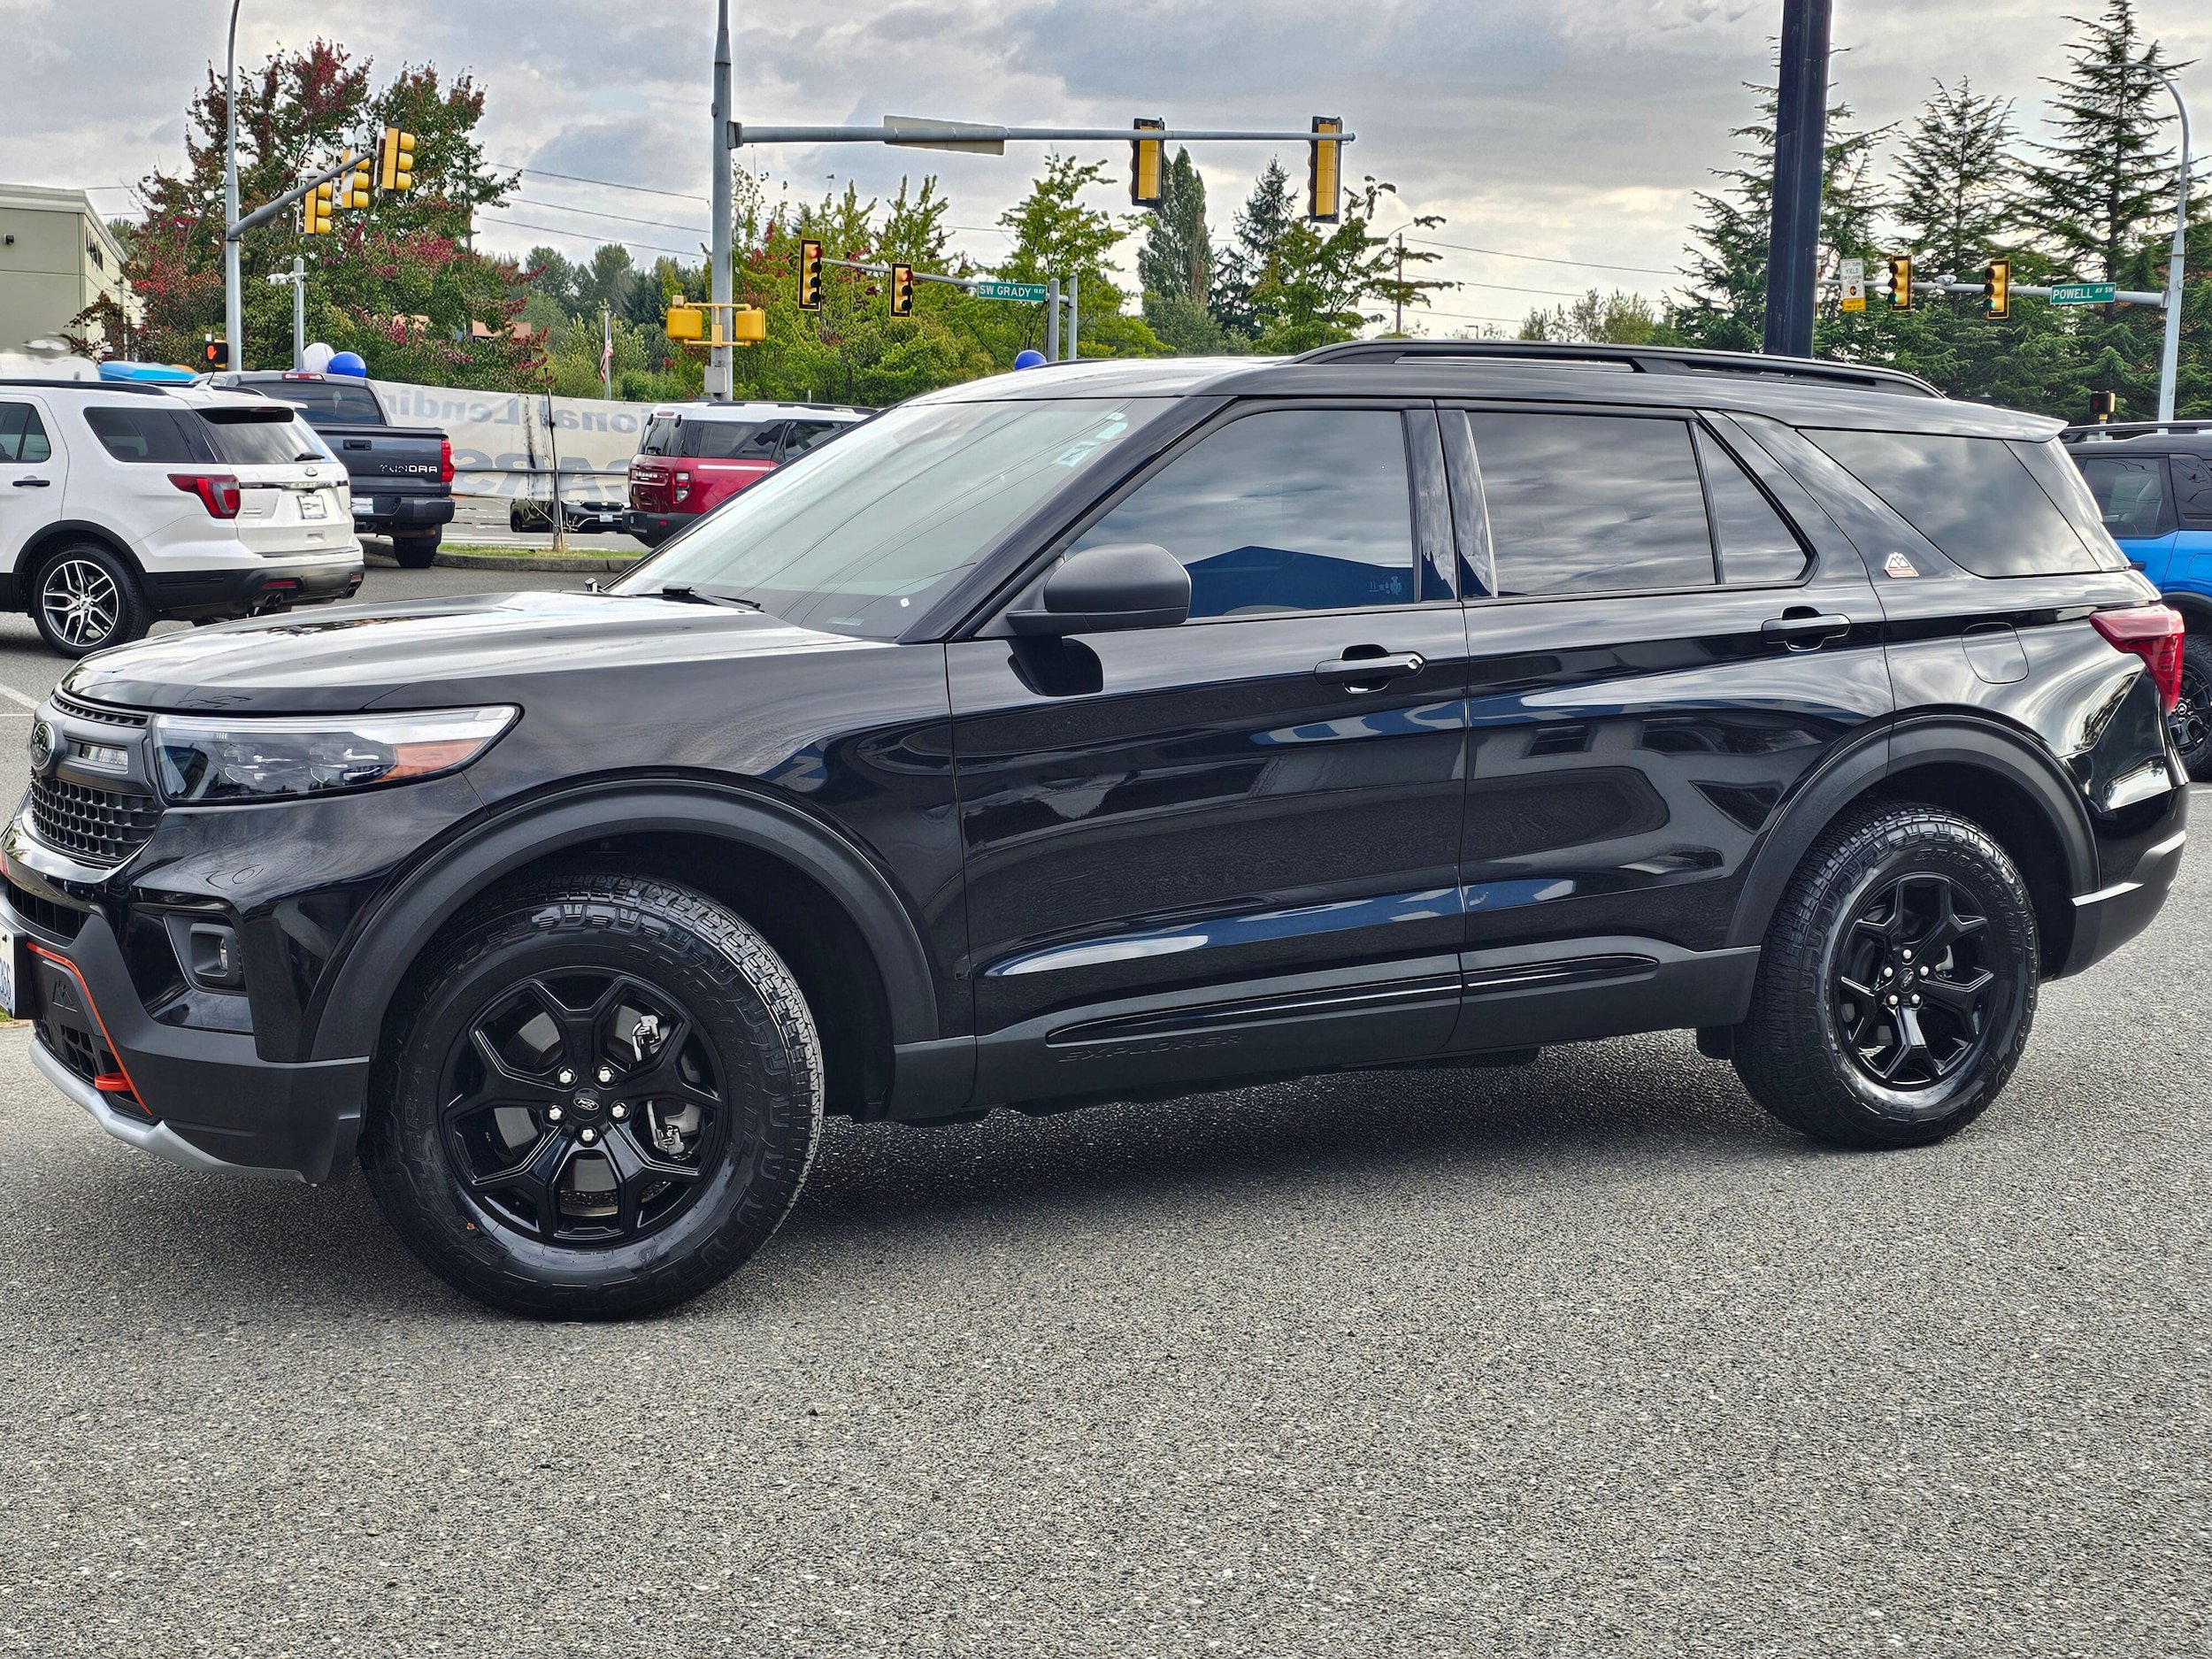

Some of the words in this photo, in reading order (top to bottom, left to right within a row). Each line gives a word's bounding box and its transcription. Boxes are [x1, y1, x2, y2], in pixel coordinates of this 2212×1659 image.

[979, 285, 994, 295] SW
[997, 286, 1031, 297] GRADY
[2053, 288, 2093, 300] POWELL
[1058, 1035, 1241, 1063] EXPLORER
